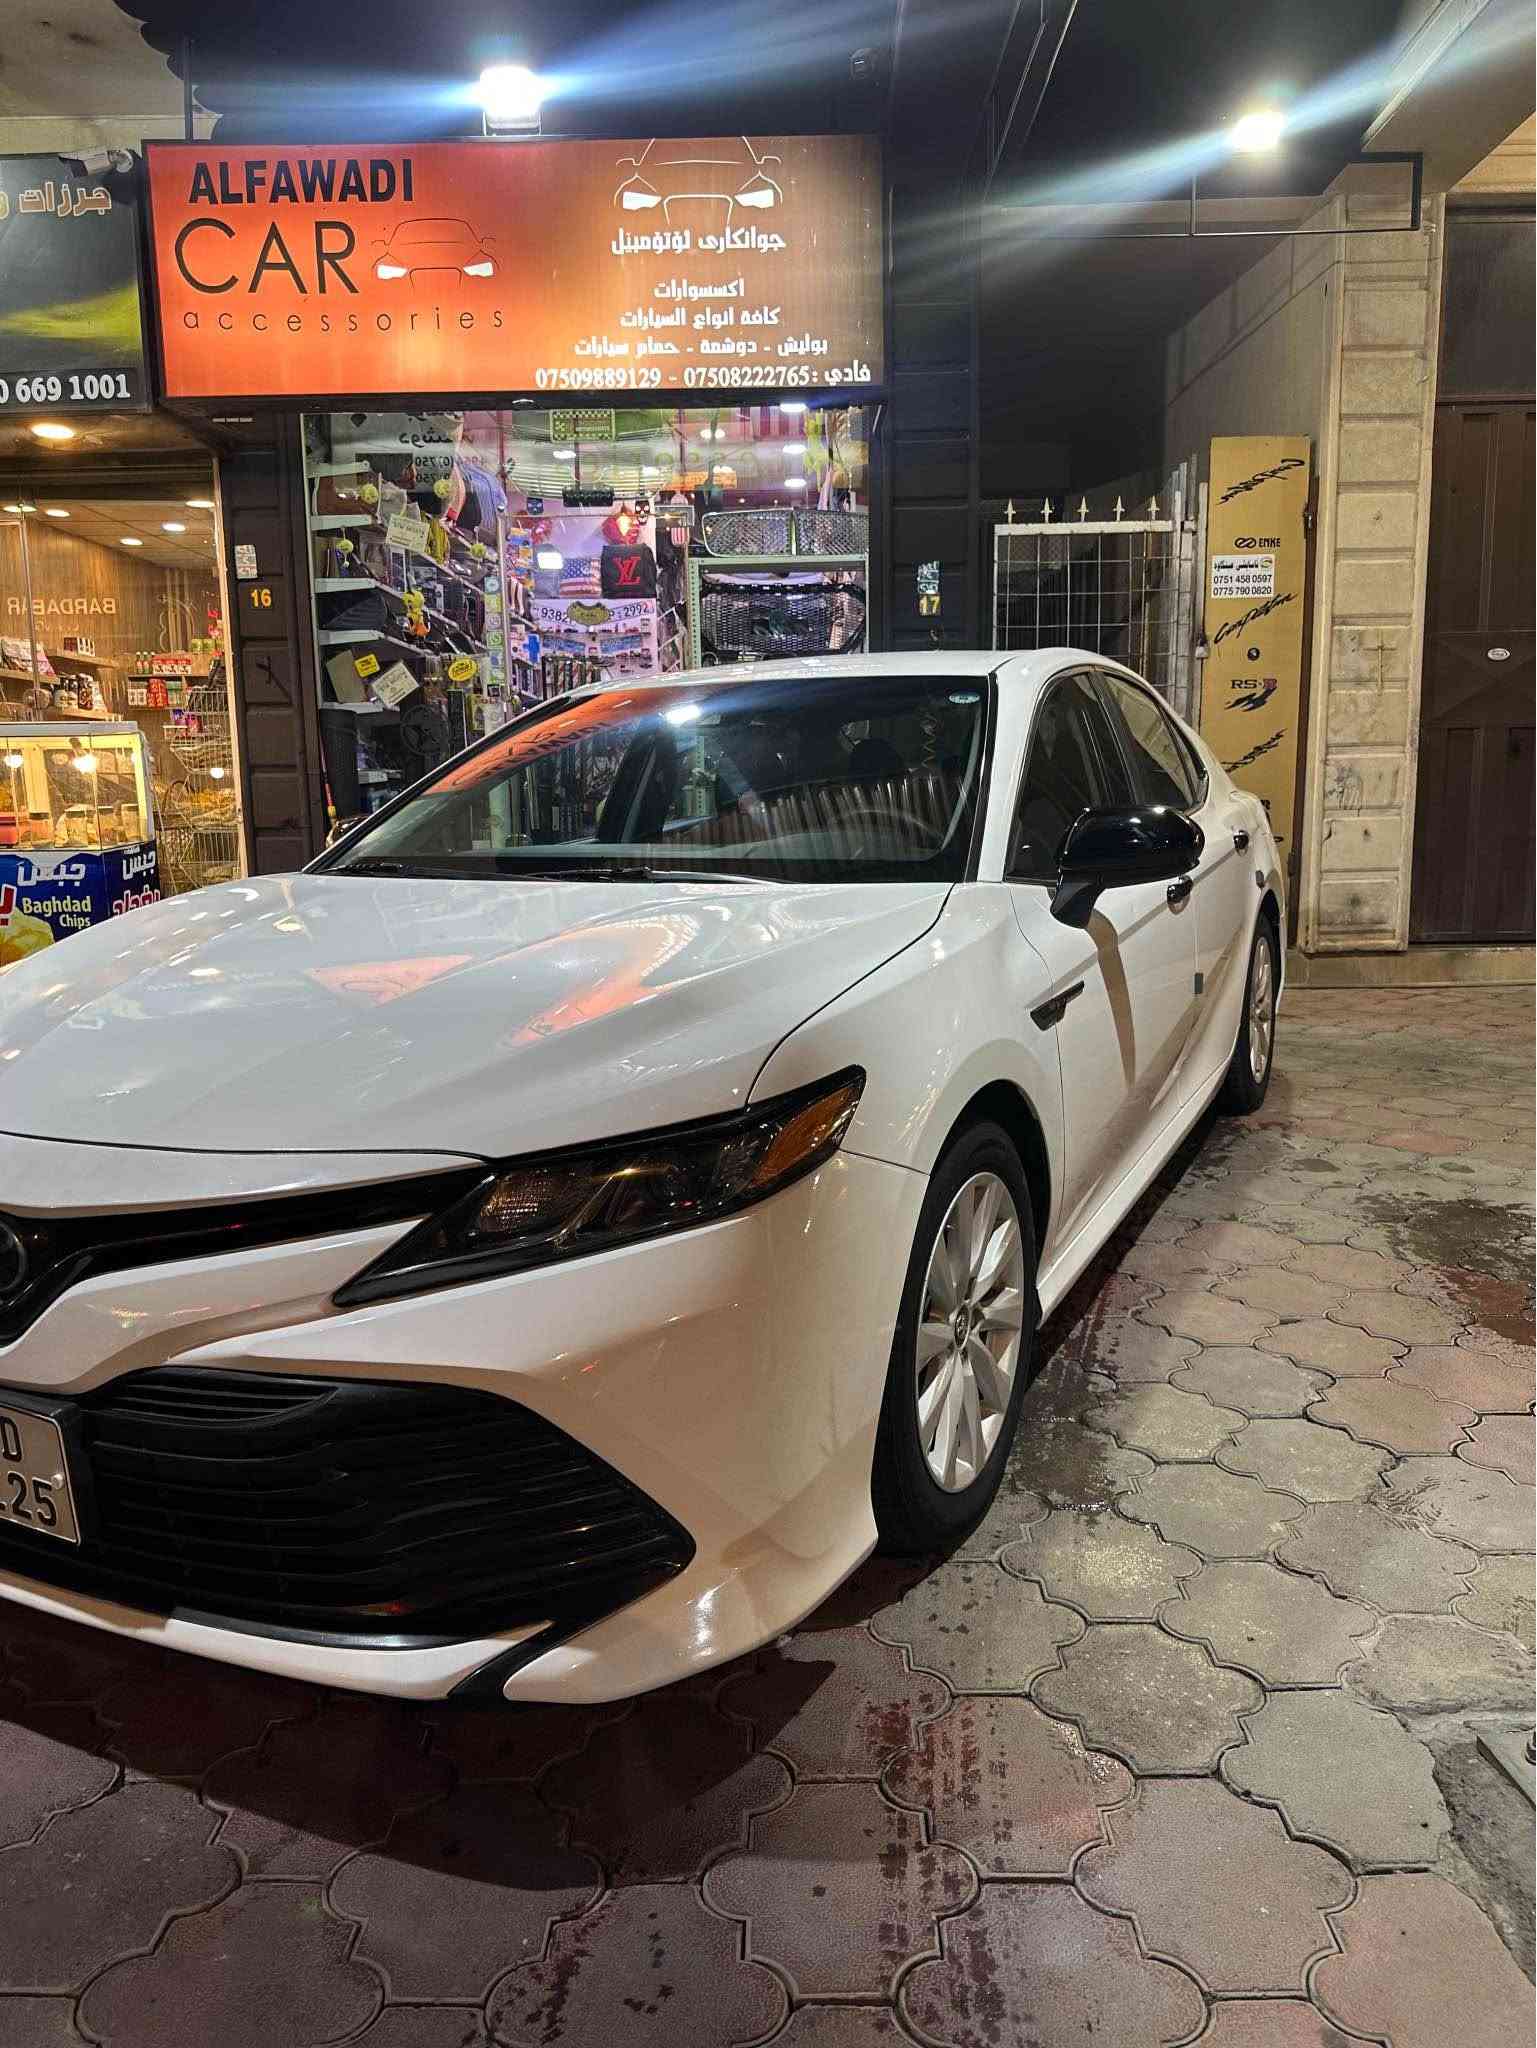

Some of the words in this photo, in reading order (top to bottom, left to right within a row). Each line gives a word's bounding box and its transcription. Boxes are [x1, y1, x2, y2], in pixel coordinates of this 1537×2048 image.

[189, 159, 413, 204] ALFAWADI
[174, 217, 360, 294] CAR
[183, 306, 503, 333] accessories
[620, 307, 687, 331] السيارات
[15, 377, 62, 404] 669
[69, 373, 131, 400] 1001
[535, 367, 662, 390] 07509889129
[1213, 575, 1233, 585] 0751
[251, 588, 272, 608] 16
[22, 895, 92, 917] Baghdad
[59, 914, 91, 929] Chips
